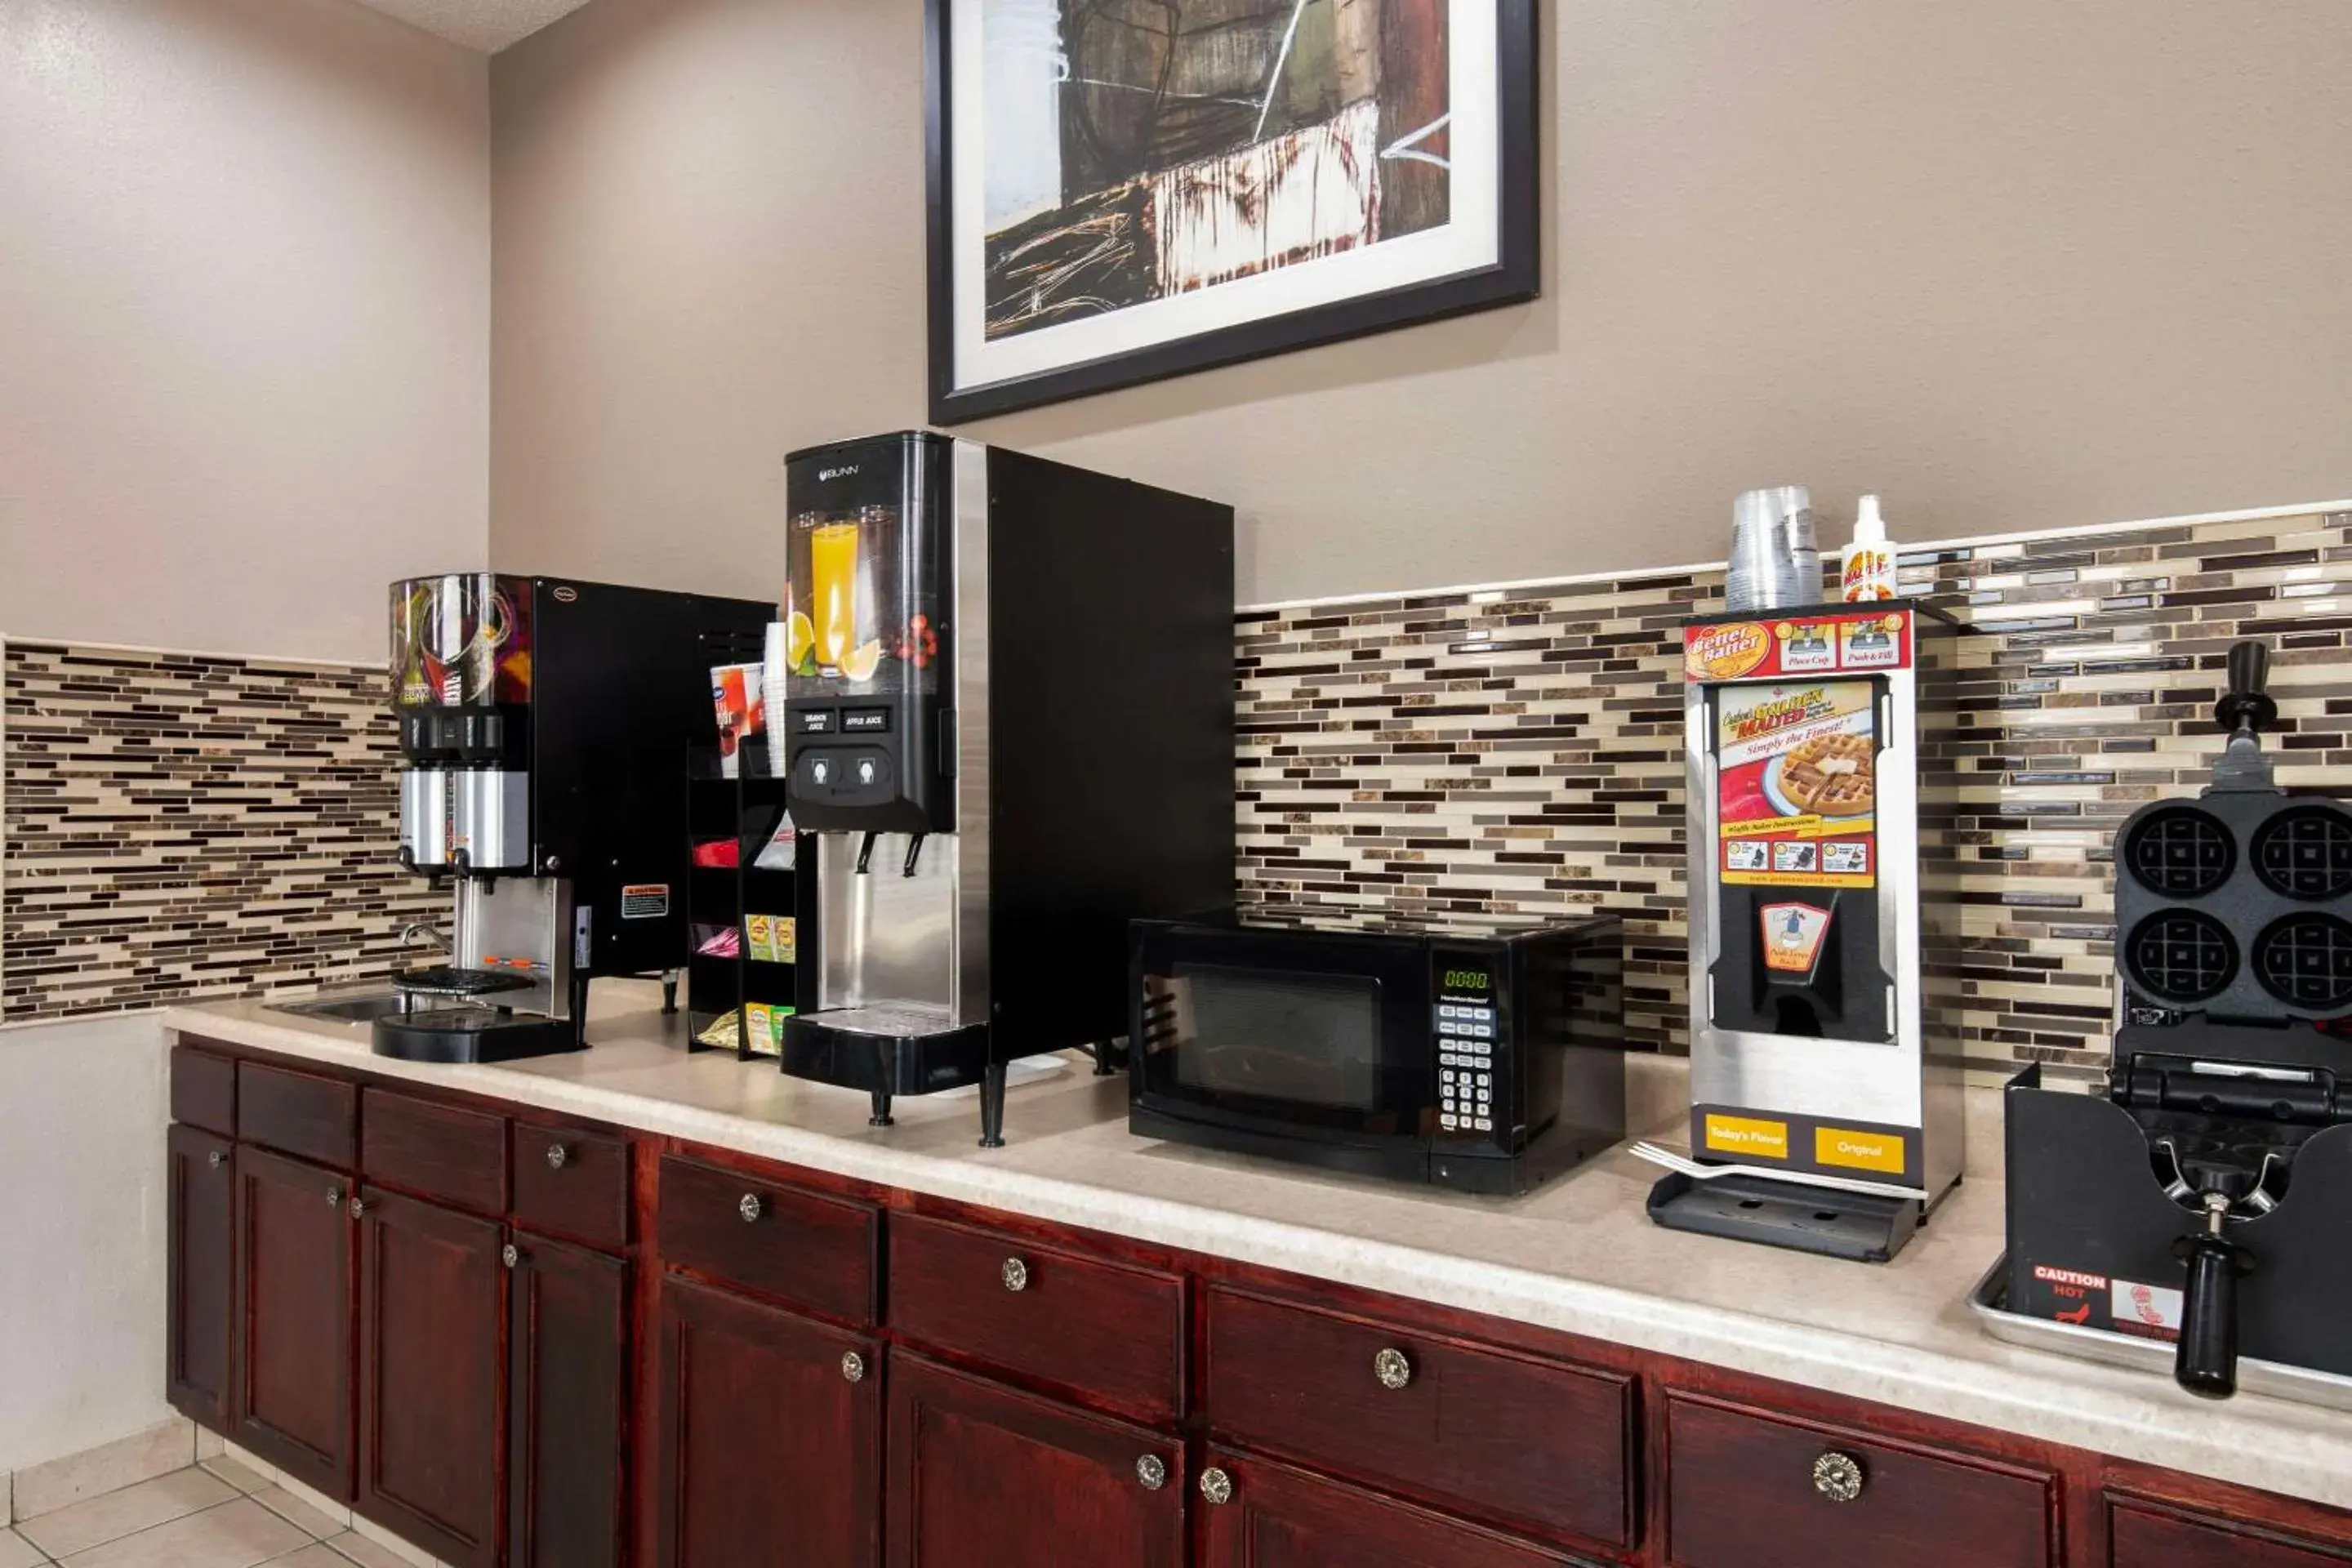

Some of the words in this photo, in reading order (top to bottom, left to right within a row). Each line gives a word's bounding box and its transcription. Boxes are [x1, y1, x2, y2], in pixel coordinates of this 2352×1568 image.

[827, 465, 859, 479] BUNN
[1692, 626, 1748, 653] Better
[1704, 635, 1759, 662] Batter
[1812, 655, 1829, 666] Cup
[1736, 707, 1806, 738] MALTED
[1746, 738, 1784, 755] Simply
[1785, 733, 1802, 745] the
[1711, 1125, 1748, 1143] Today's
[1837, 1140, 1882, 1156] Original
[2034, 1265, 2106, 1289] CAUTION
[2054, 1285, 2085, 1298] HOT
